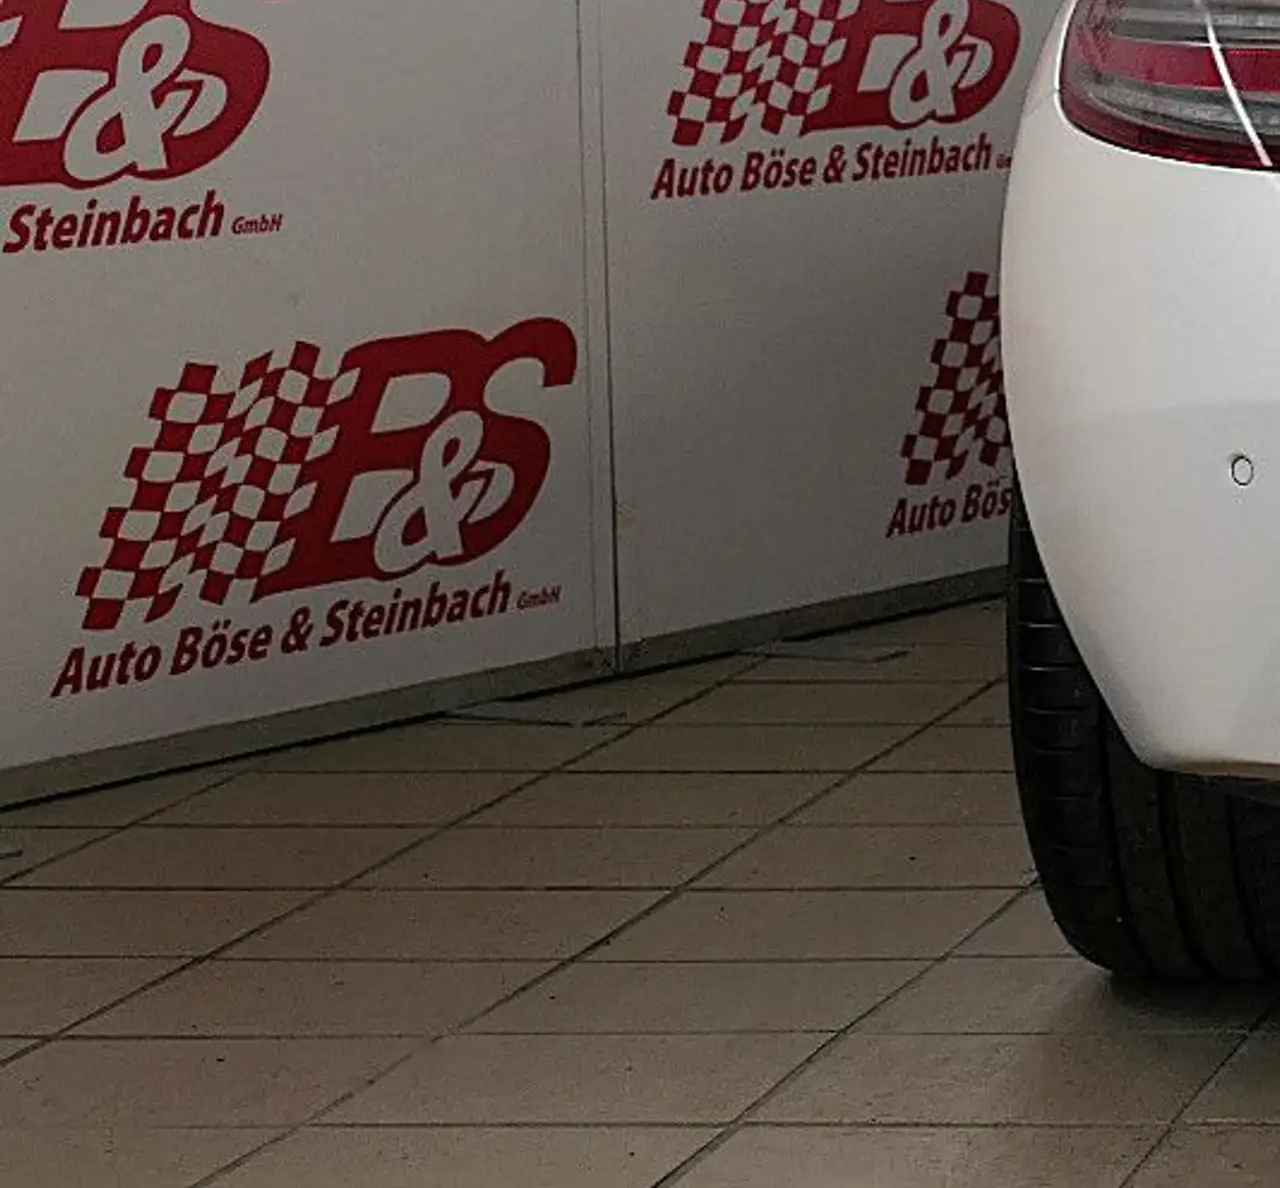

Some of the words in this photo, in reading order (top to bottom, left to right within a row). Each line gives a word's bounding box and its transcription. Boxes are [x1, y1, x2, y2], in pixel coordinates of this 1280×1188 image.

[650, 156, 734, 200] Auto
[740, 147, 818, 193] Böse
[822, 144, 848, 186] &
[851, 132, 993, 183] Steinbach
[2, 189, 226, 253] Steinbach
[231, 214, 284, 236] GmbH
[885, 494, 957, 539] Auto
[50, 639, 163, 699] Auto
[169, 617, 274, 676] Böse
[280, 605, 315, 654] &
[319, 568, 513, 647] Steinbach
[515, 584, 562, 611] GmbH
